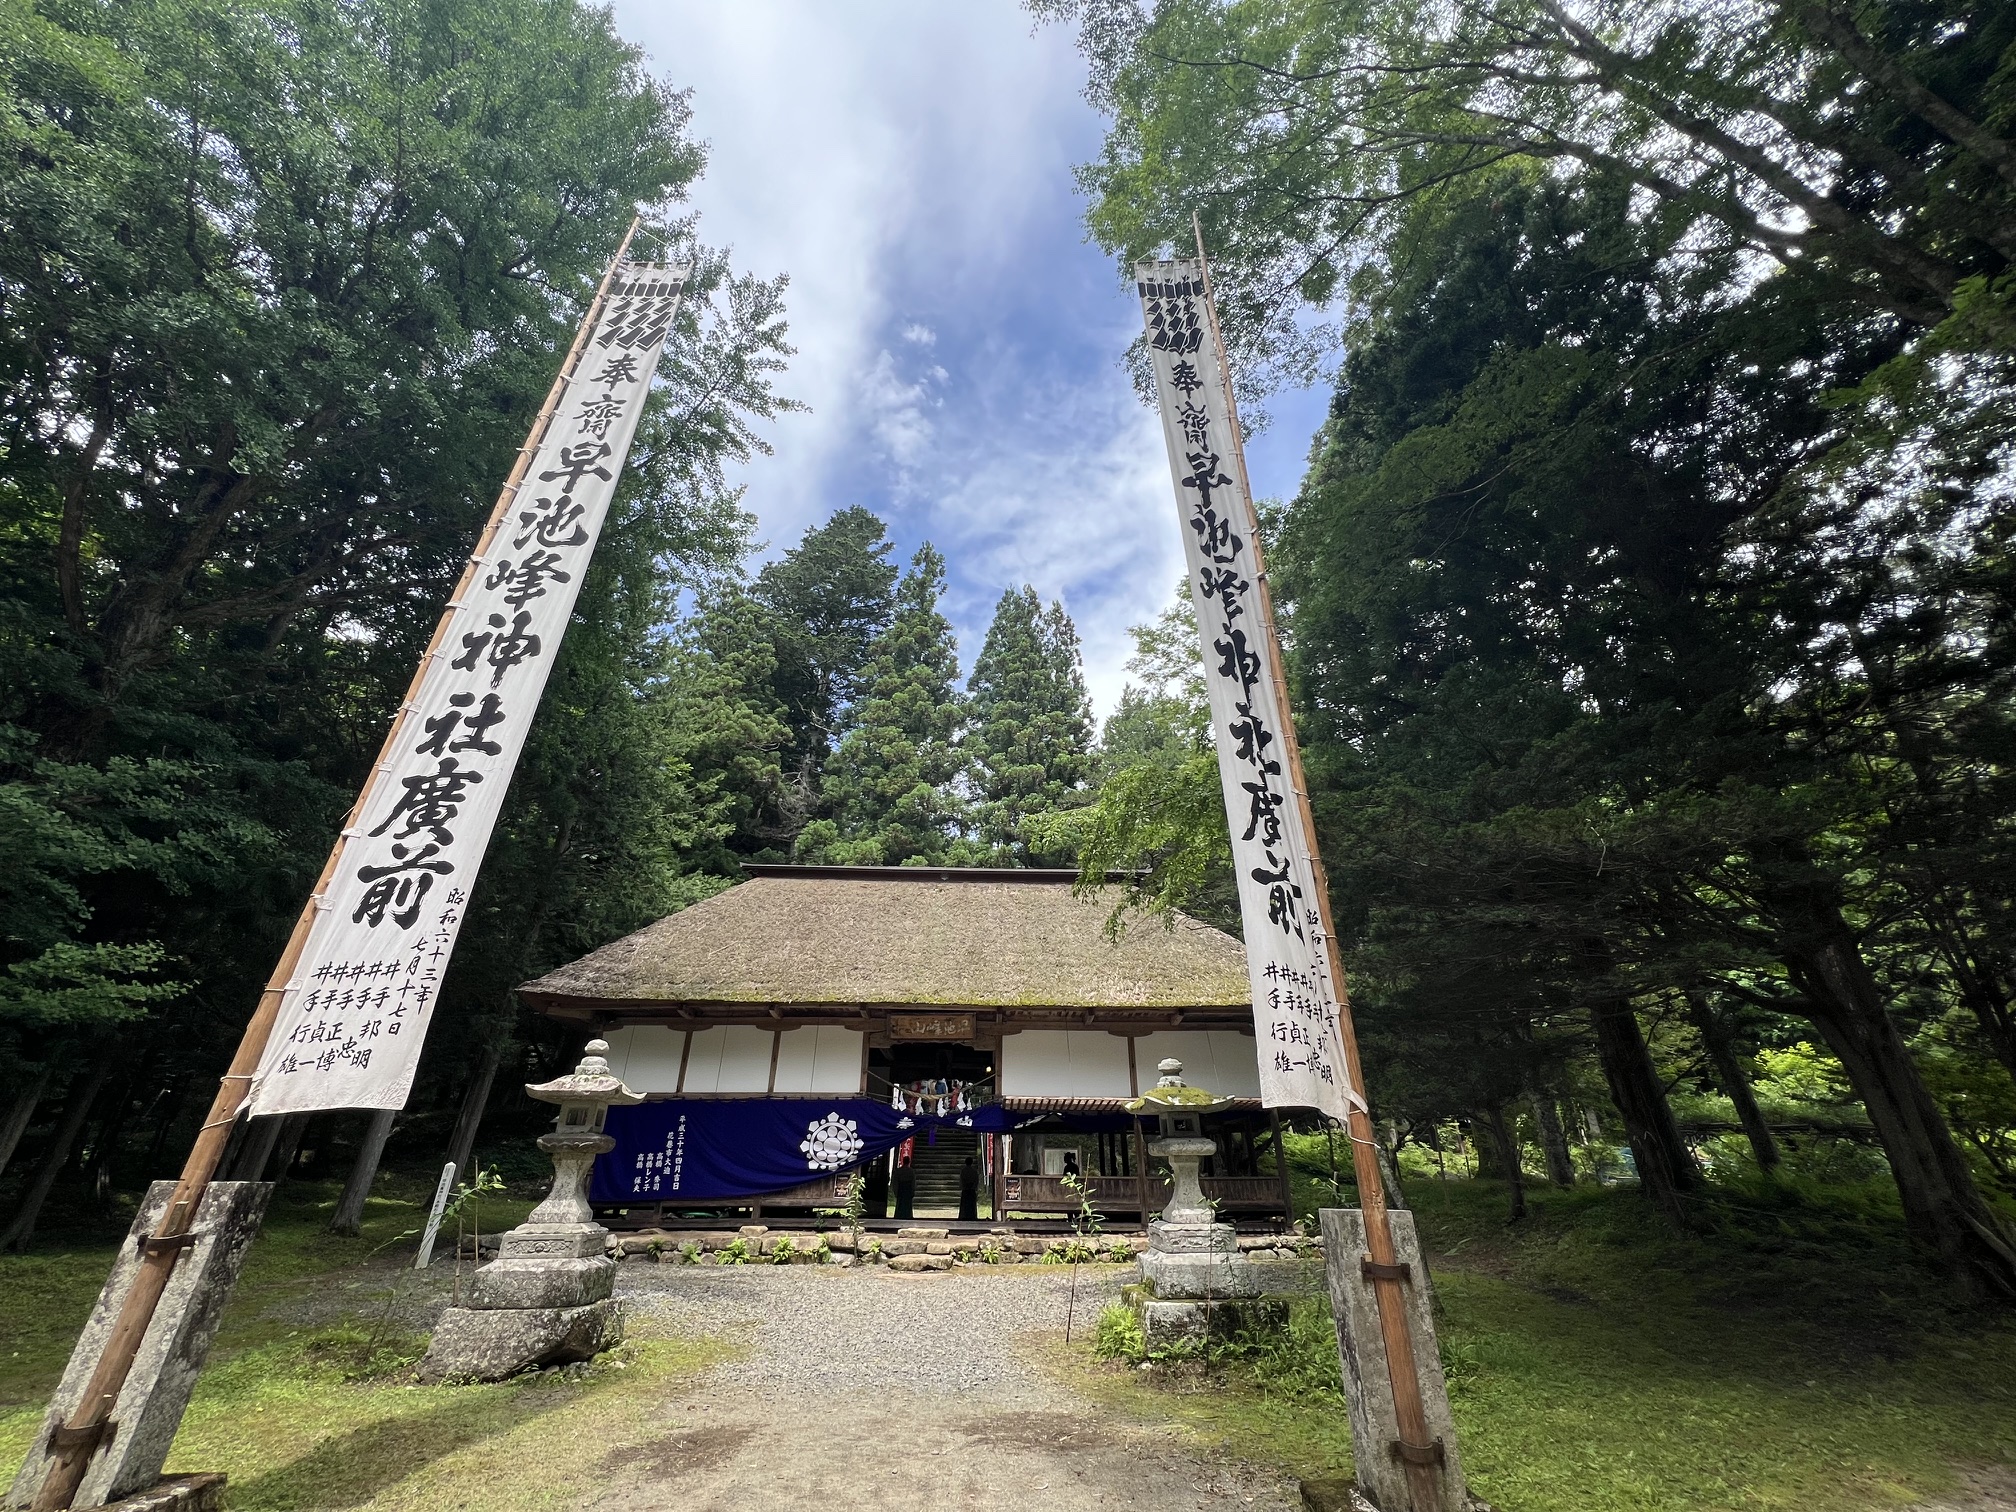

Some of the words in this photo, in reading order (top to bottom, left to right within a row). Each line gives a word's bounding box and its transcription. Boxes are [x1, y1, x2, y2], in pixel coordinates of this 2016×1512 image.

[388, 936, 428, 1035] 七月十七日
[415, 887, 464, 1014] 昭和六十三年
[672, 1115, 686, 1190] 平成三十年四月吉日
